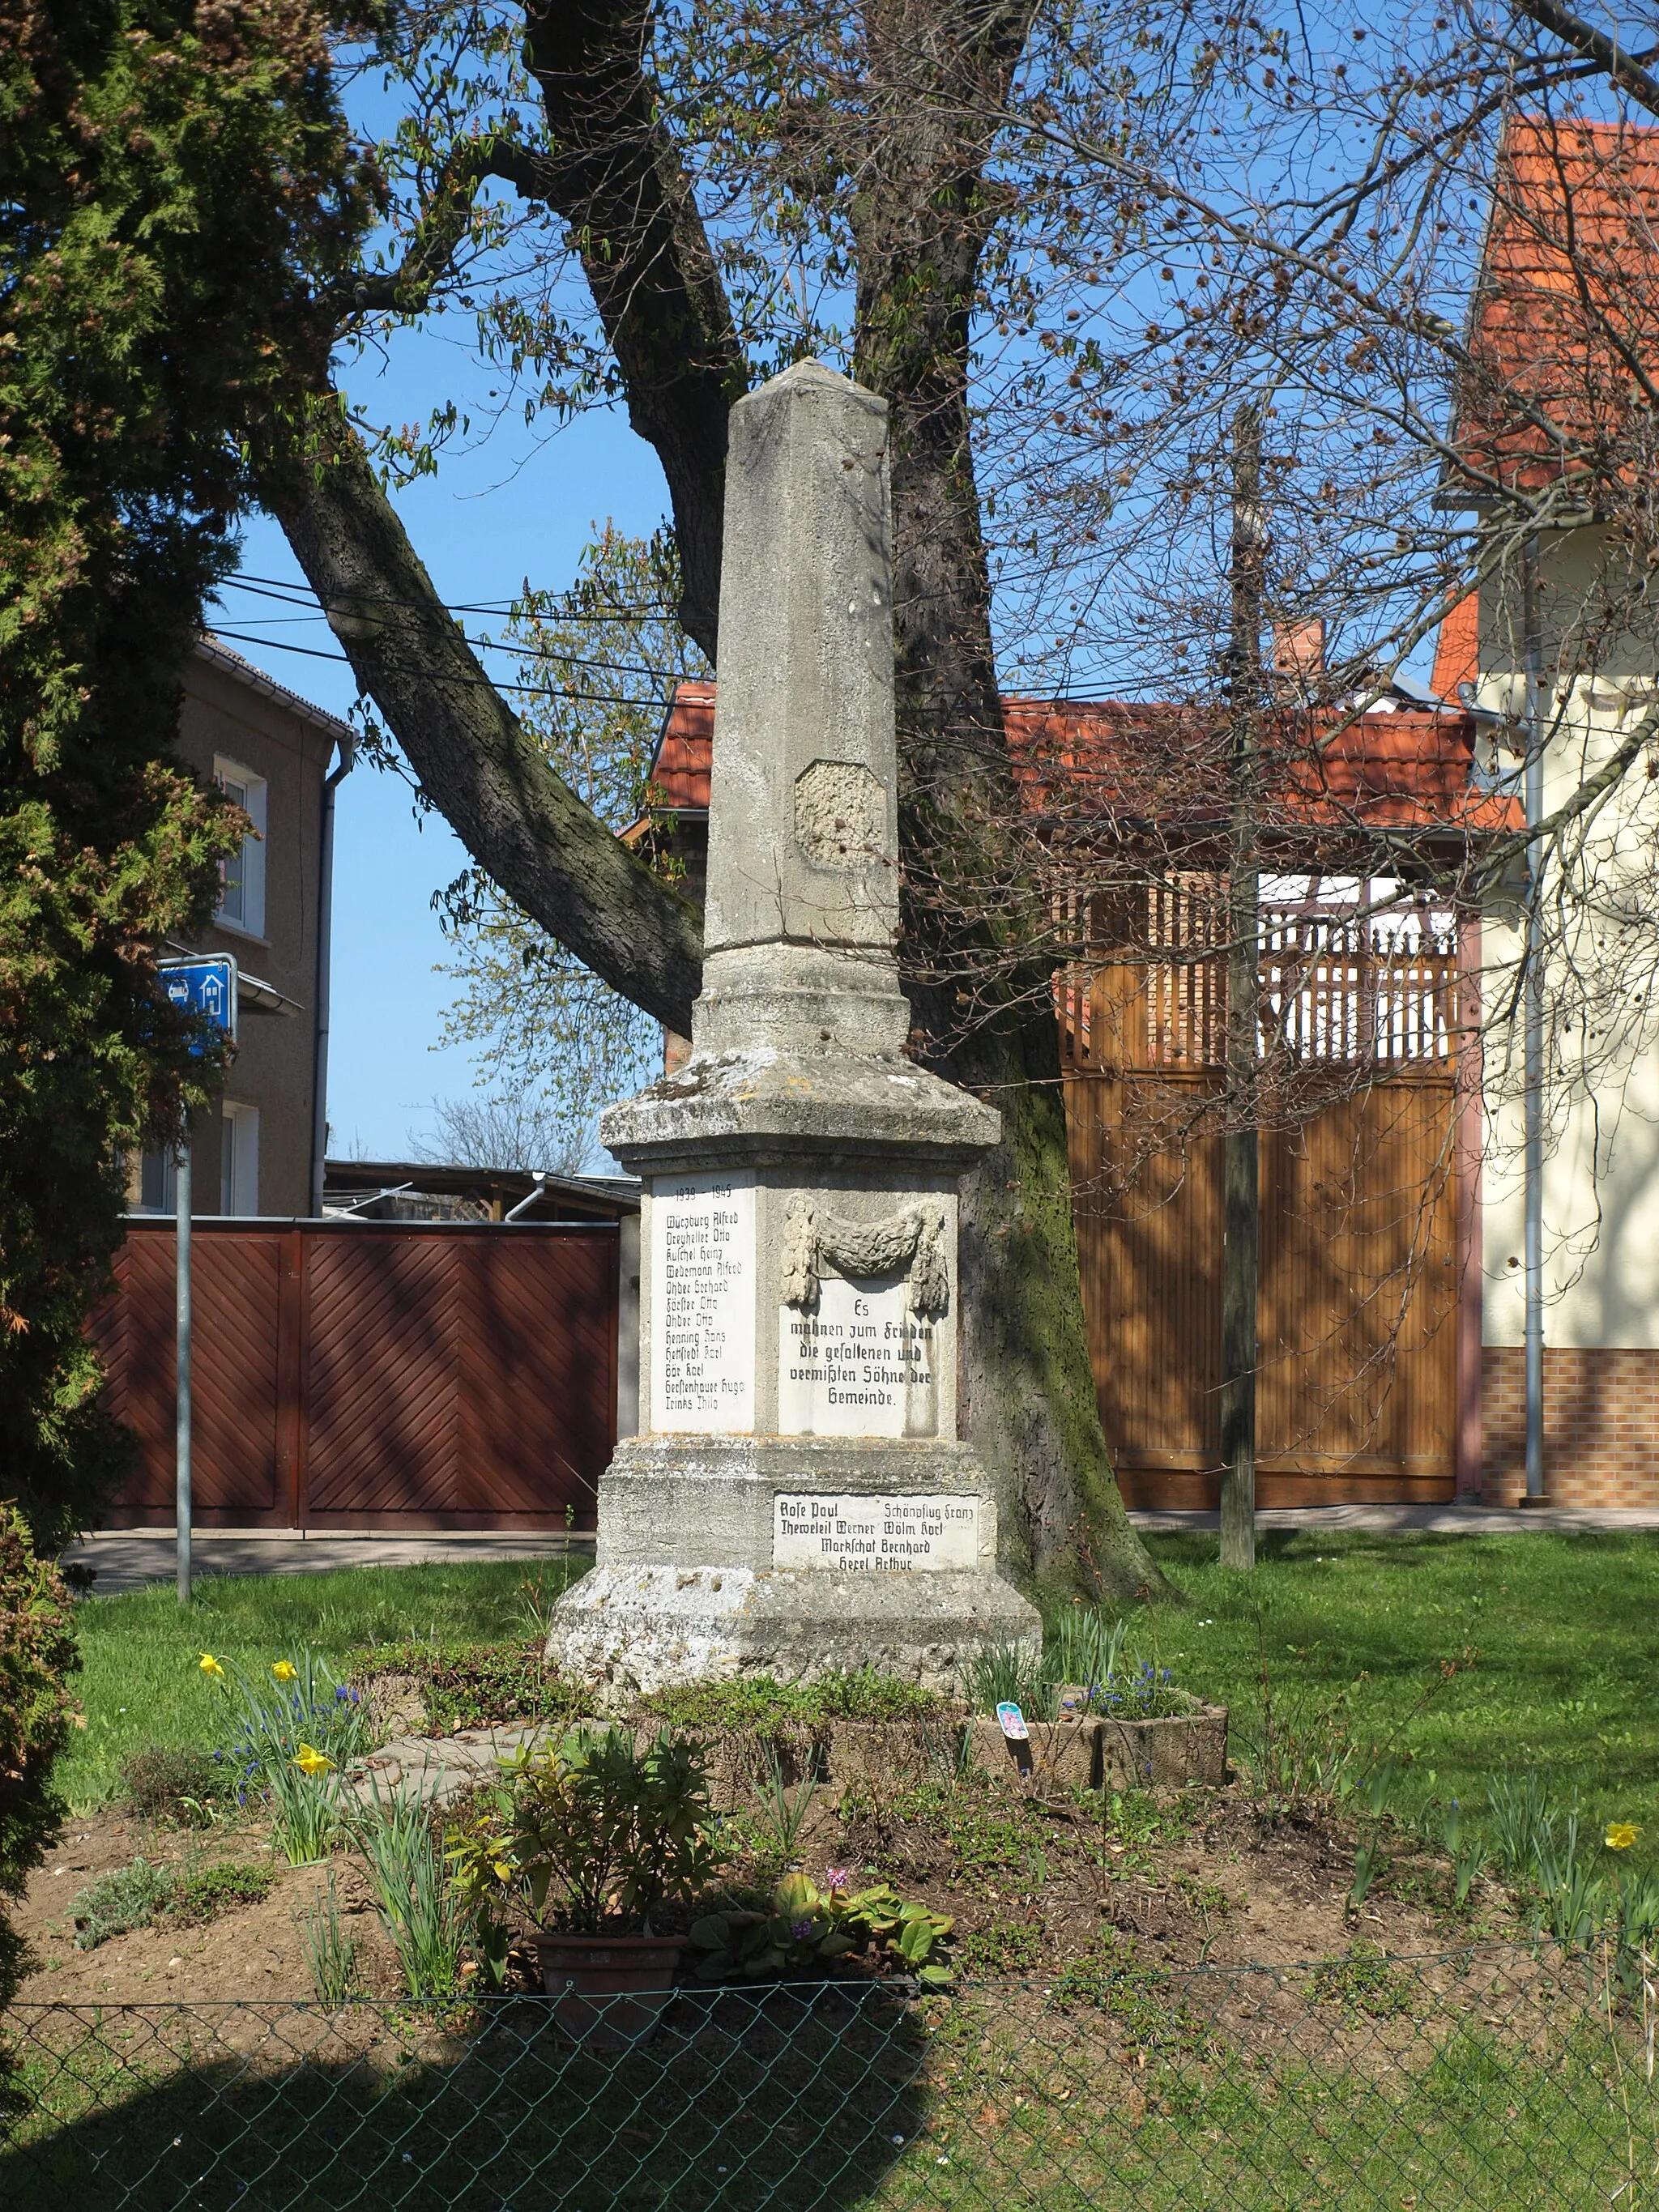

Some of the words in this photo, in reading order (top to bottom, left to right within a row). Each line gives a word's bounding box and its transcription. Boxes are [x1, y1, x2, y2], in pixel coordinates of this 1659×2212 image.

[676, 1187, 696, 1201] 1939
[712, 1184, 731, 1199] 1945
[667, 1215, 709, 1229] Würzburg
[713, 1211, 739, 1227] Alfred
[713, 1228, 730, 1242] Otto
[700, 1246, 723, 1262] Heinz
[666, 1264, 713, 1278] Wedemann
[717, 1261, 742, 1276] Alfred
[694, 1279, 728, 1294] Gerhard
[700, 1296, 718, 1310] Otto
[854, 1299, 869, 1316] Es
[696, 1313, 713, 1327] Otto
[666, 1331, 699, 1347] Henning
[704, 1329, 726, 1344] Hans
[791, 1319, 843, 1337] mahnen
[849, 1325, 876, 1339] zum
[884, 1322, 933, 1340] Frieden
[704, 1345, 722, 1359] Karl
[800, 1341, 819, 1358] die
[825, 1342, 891, 1362] gefallenen
[898, 1345, 921, 1362] und
[686, 1362, 704, 1377] Karl
[790, 1365, 856, 1384] vermißten
[863, 1366, 904, 1385] Söhne
[910, 1367, 931, 1384] der
[722, 1378, 744, 1396] Hugo
[828, 1387, 897, 1406] Gemeinde.
[811, 1502, 838, 1519] Paul
[945, 1504, 974, 1519] Franz
[836, 1520, 875, 1534] Werner
[921, 1521, 943, 1536] Karl
[881, 1538, 930, 1555] Bernhard
[875, 1556, 912, 1571] Arthur
